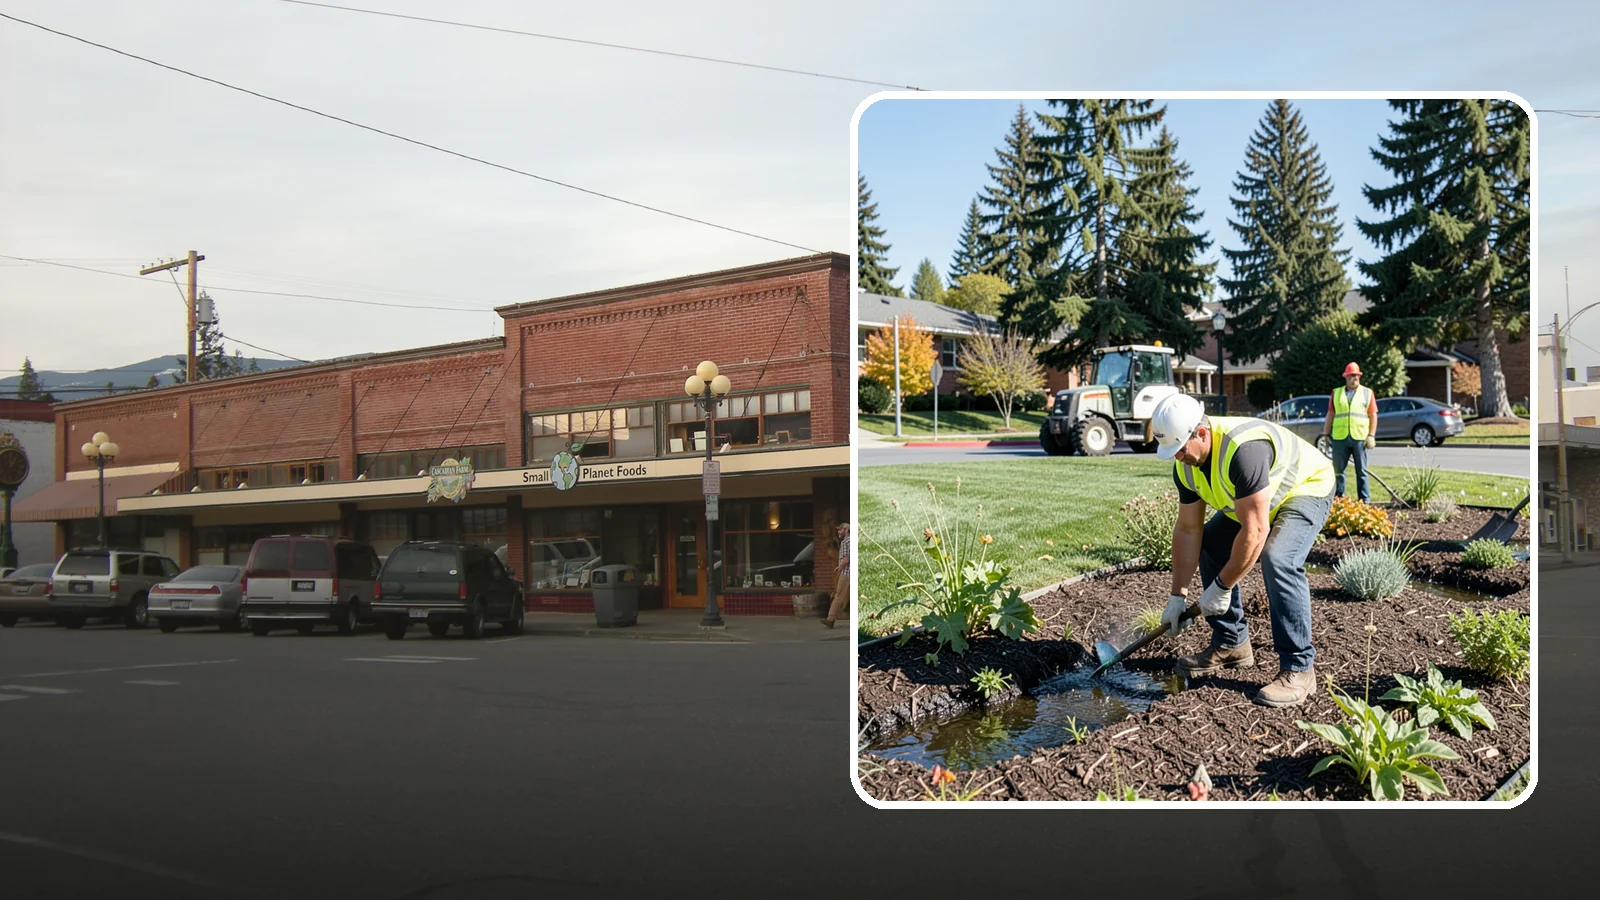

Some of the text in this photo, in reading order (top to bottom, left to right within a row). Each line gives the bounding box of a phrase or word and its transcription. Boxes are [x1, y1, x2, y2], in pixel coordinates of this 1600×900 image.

[523, 464, 647, 482] Small Planet Foods
